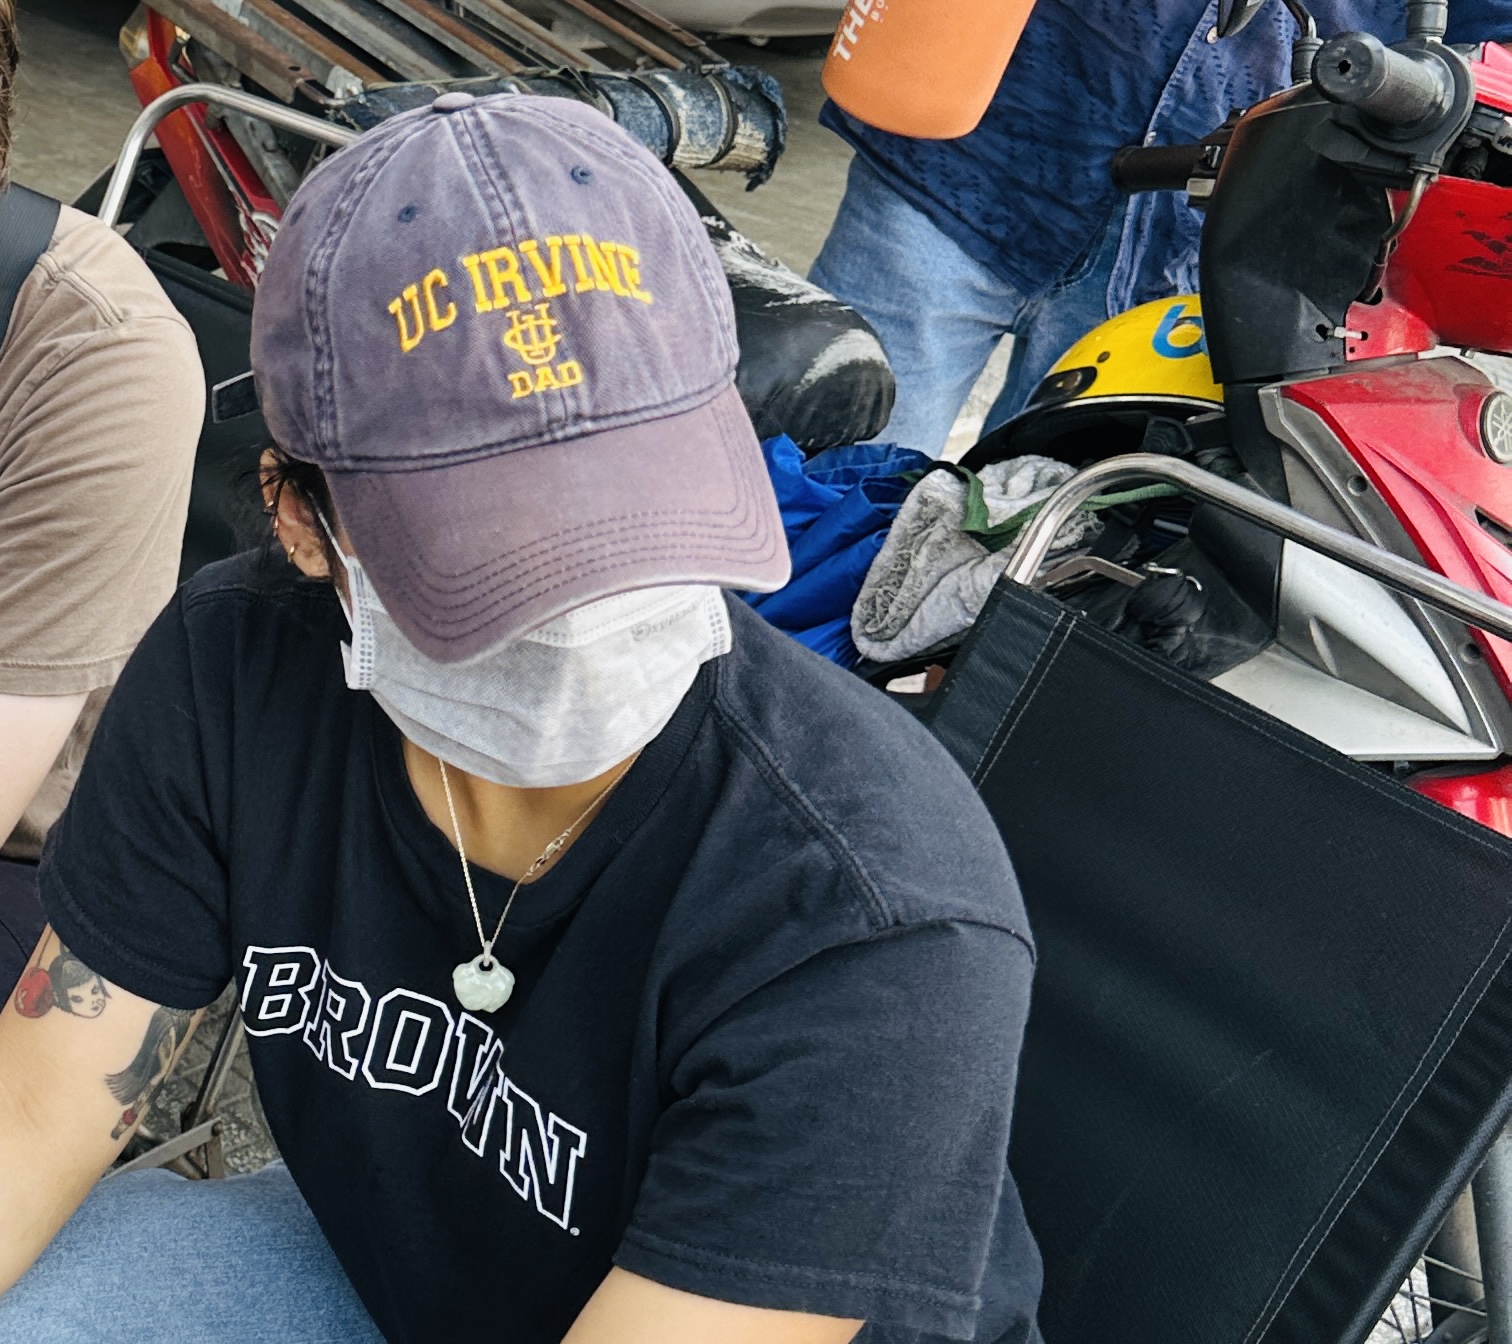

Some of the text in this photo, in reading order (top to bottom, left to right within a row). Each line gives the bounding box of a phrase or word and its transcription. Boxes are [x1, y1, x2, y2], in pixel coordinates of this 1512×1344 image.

[388, 234, 654, 353] UC IRVINE
[508, 360, 584, 400] DAD
[240, 945, 587, 1230] BROWN
